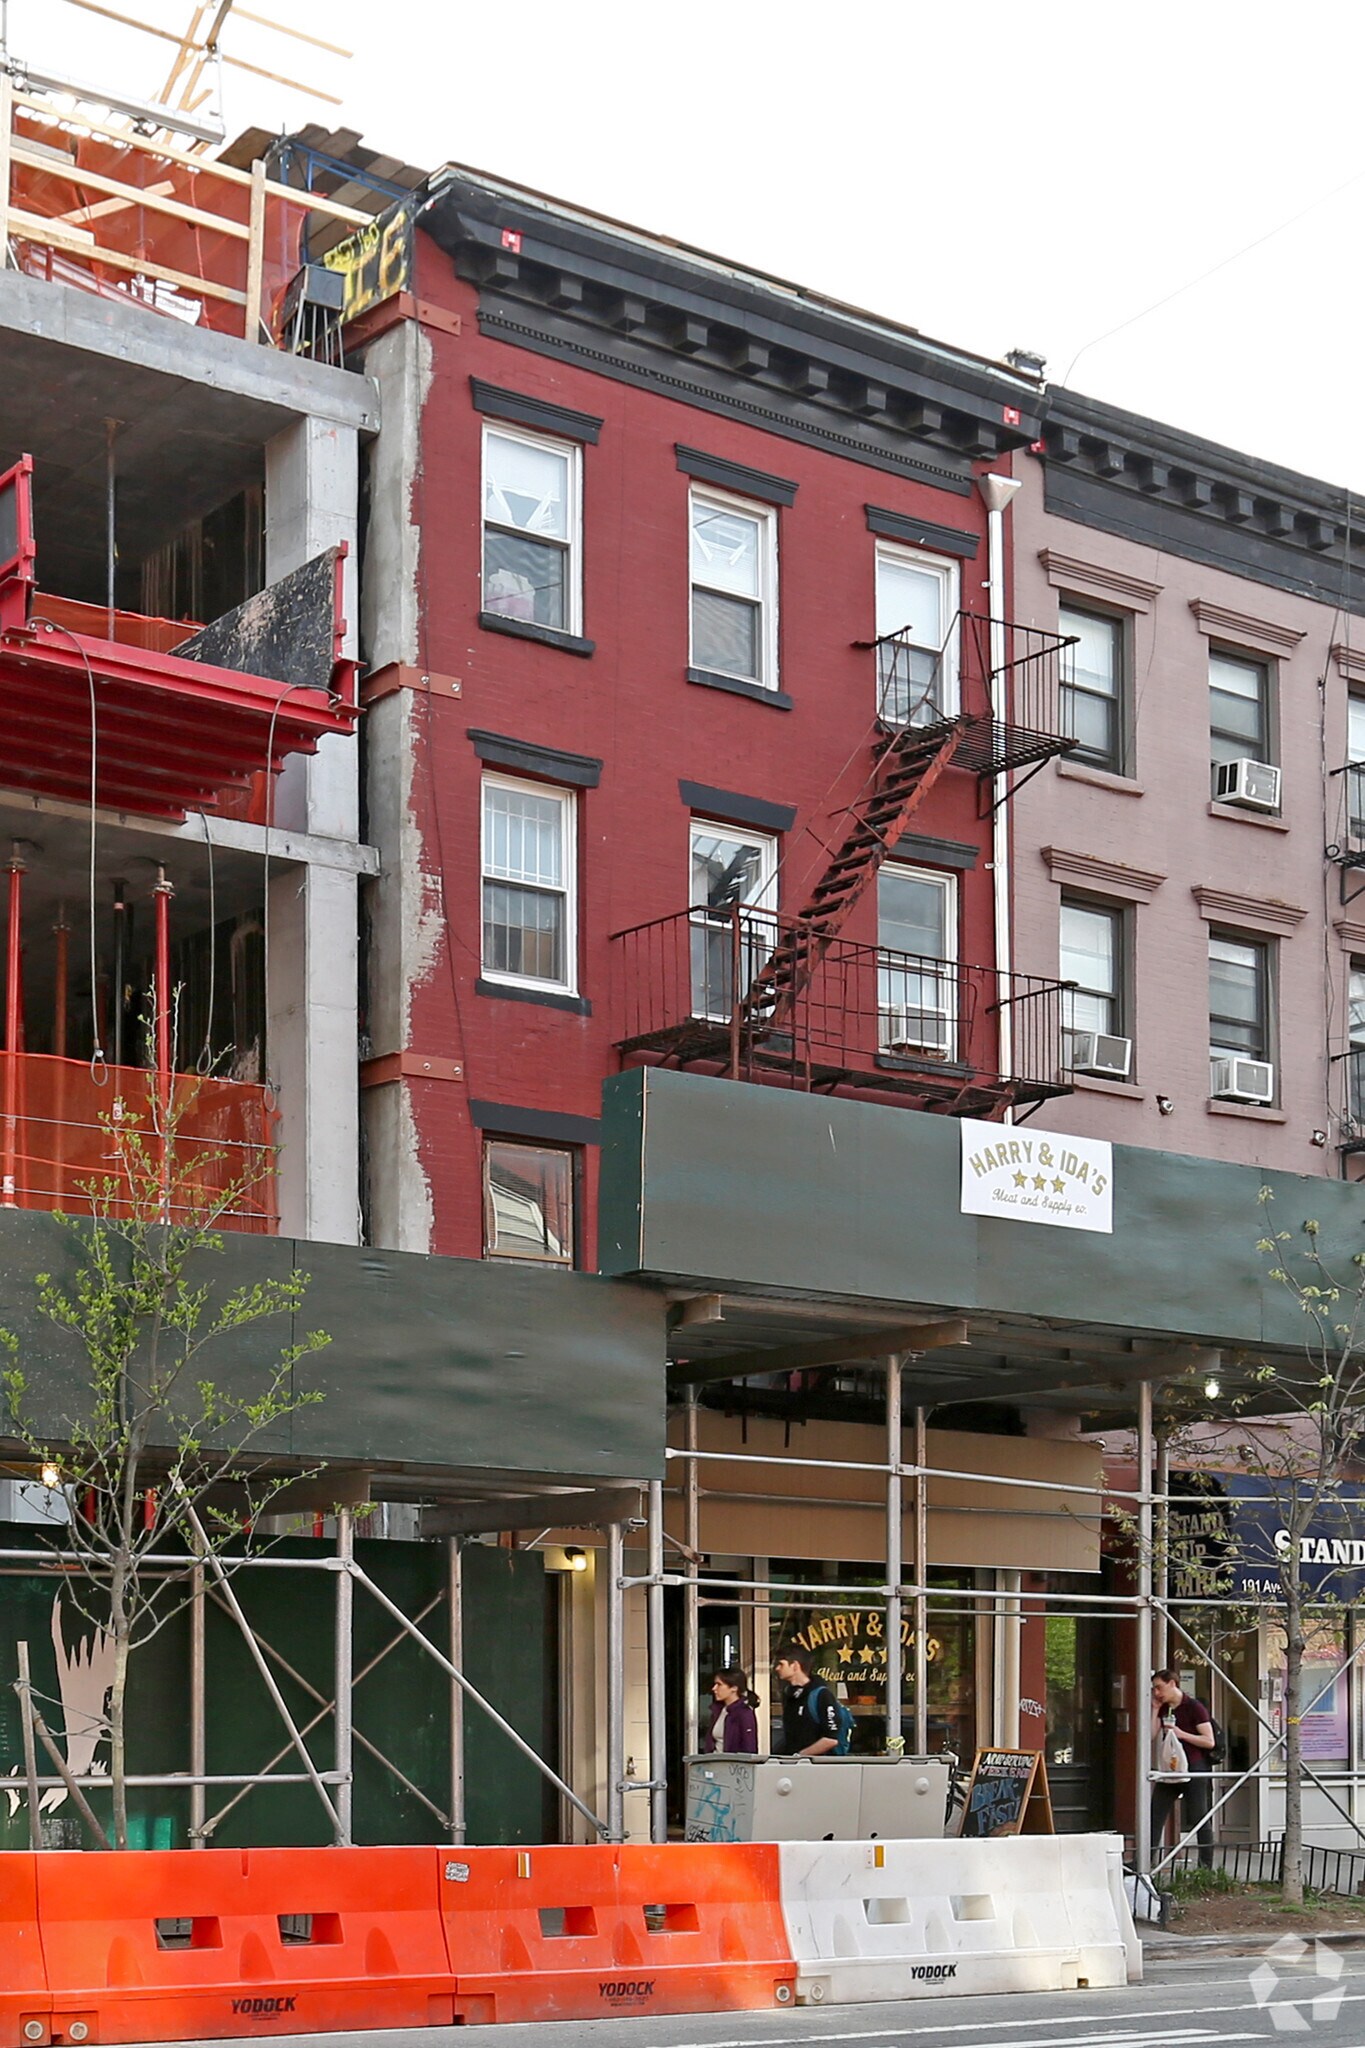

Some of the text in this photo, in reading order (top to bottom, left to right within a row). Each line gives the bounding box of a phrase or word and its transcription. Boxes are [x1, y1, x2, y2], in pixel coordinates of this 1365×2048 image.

[968, 1140, 1108, 1196] HARRY & IDA'S
[992, 1188, 1018, 1203] Meat
[1021, 1194, 1039, 1207] and
[1042, 1194, 1072, 1216] Supply
[1242, 1578, 1261, 1593] 191
[791, 1612, 861, 1652] HARRY
[866, 1612, 884, 1638] &
[847, 1668, 867, 1682] and
[911, 1964, 957, 1979] YODOCK
[599, 1981, 655, 1996] YODOCK
[231, 1997, 296, 2014] YODOCK
